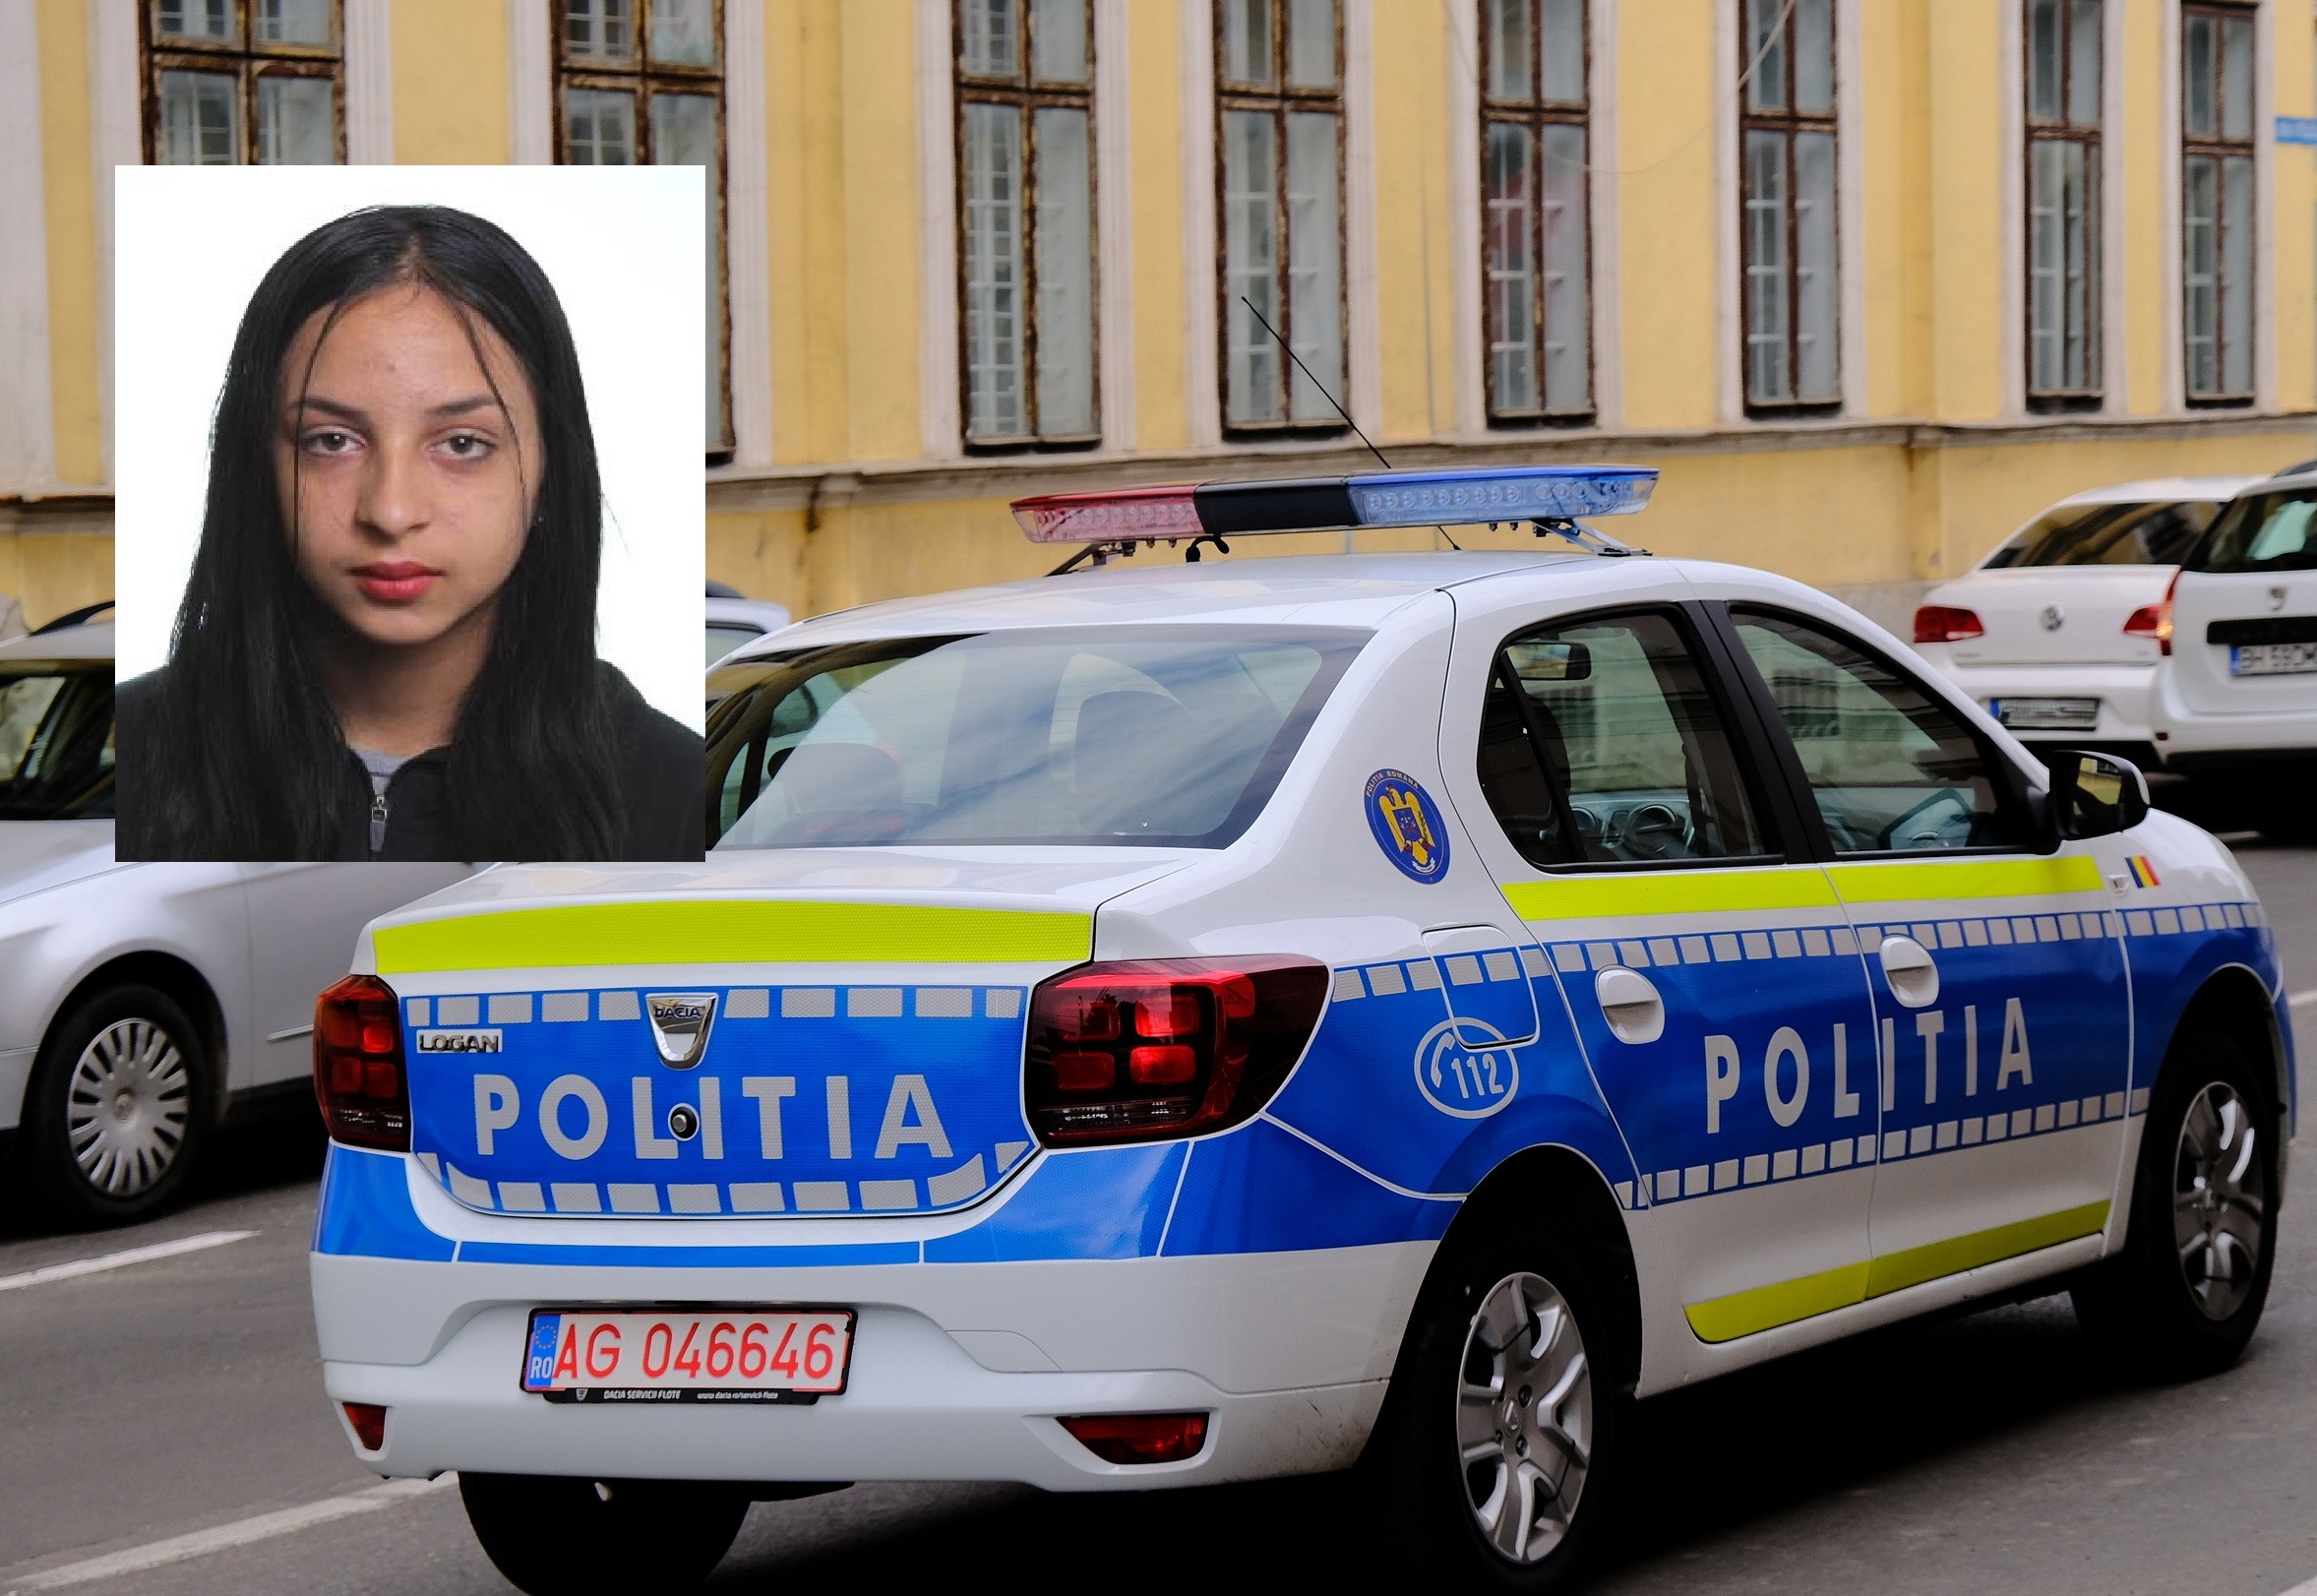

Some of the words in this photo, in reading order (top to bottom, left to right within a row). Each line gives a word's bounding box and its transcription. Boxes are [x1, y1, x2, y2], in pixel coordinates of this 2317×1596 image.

[654, 1007, 701, 1018] DACIA
[419, 1034, 499, 1053] LOGAN
[1451, 1053, 1504, 1099] 112
[1704, 997, 2034, 1135] POLITIA
[473, 1074, 953, 1160] POLITIA
[529, 1356, 553, 1380] RO
[553, 1323, 622, 1380] AG
[642, 1321, 835, 1380] 046646
[603, 1389, 627, 1399] DACIA
[657, 1389, 682, 1400] FLOTE
